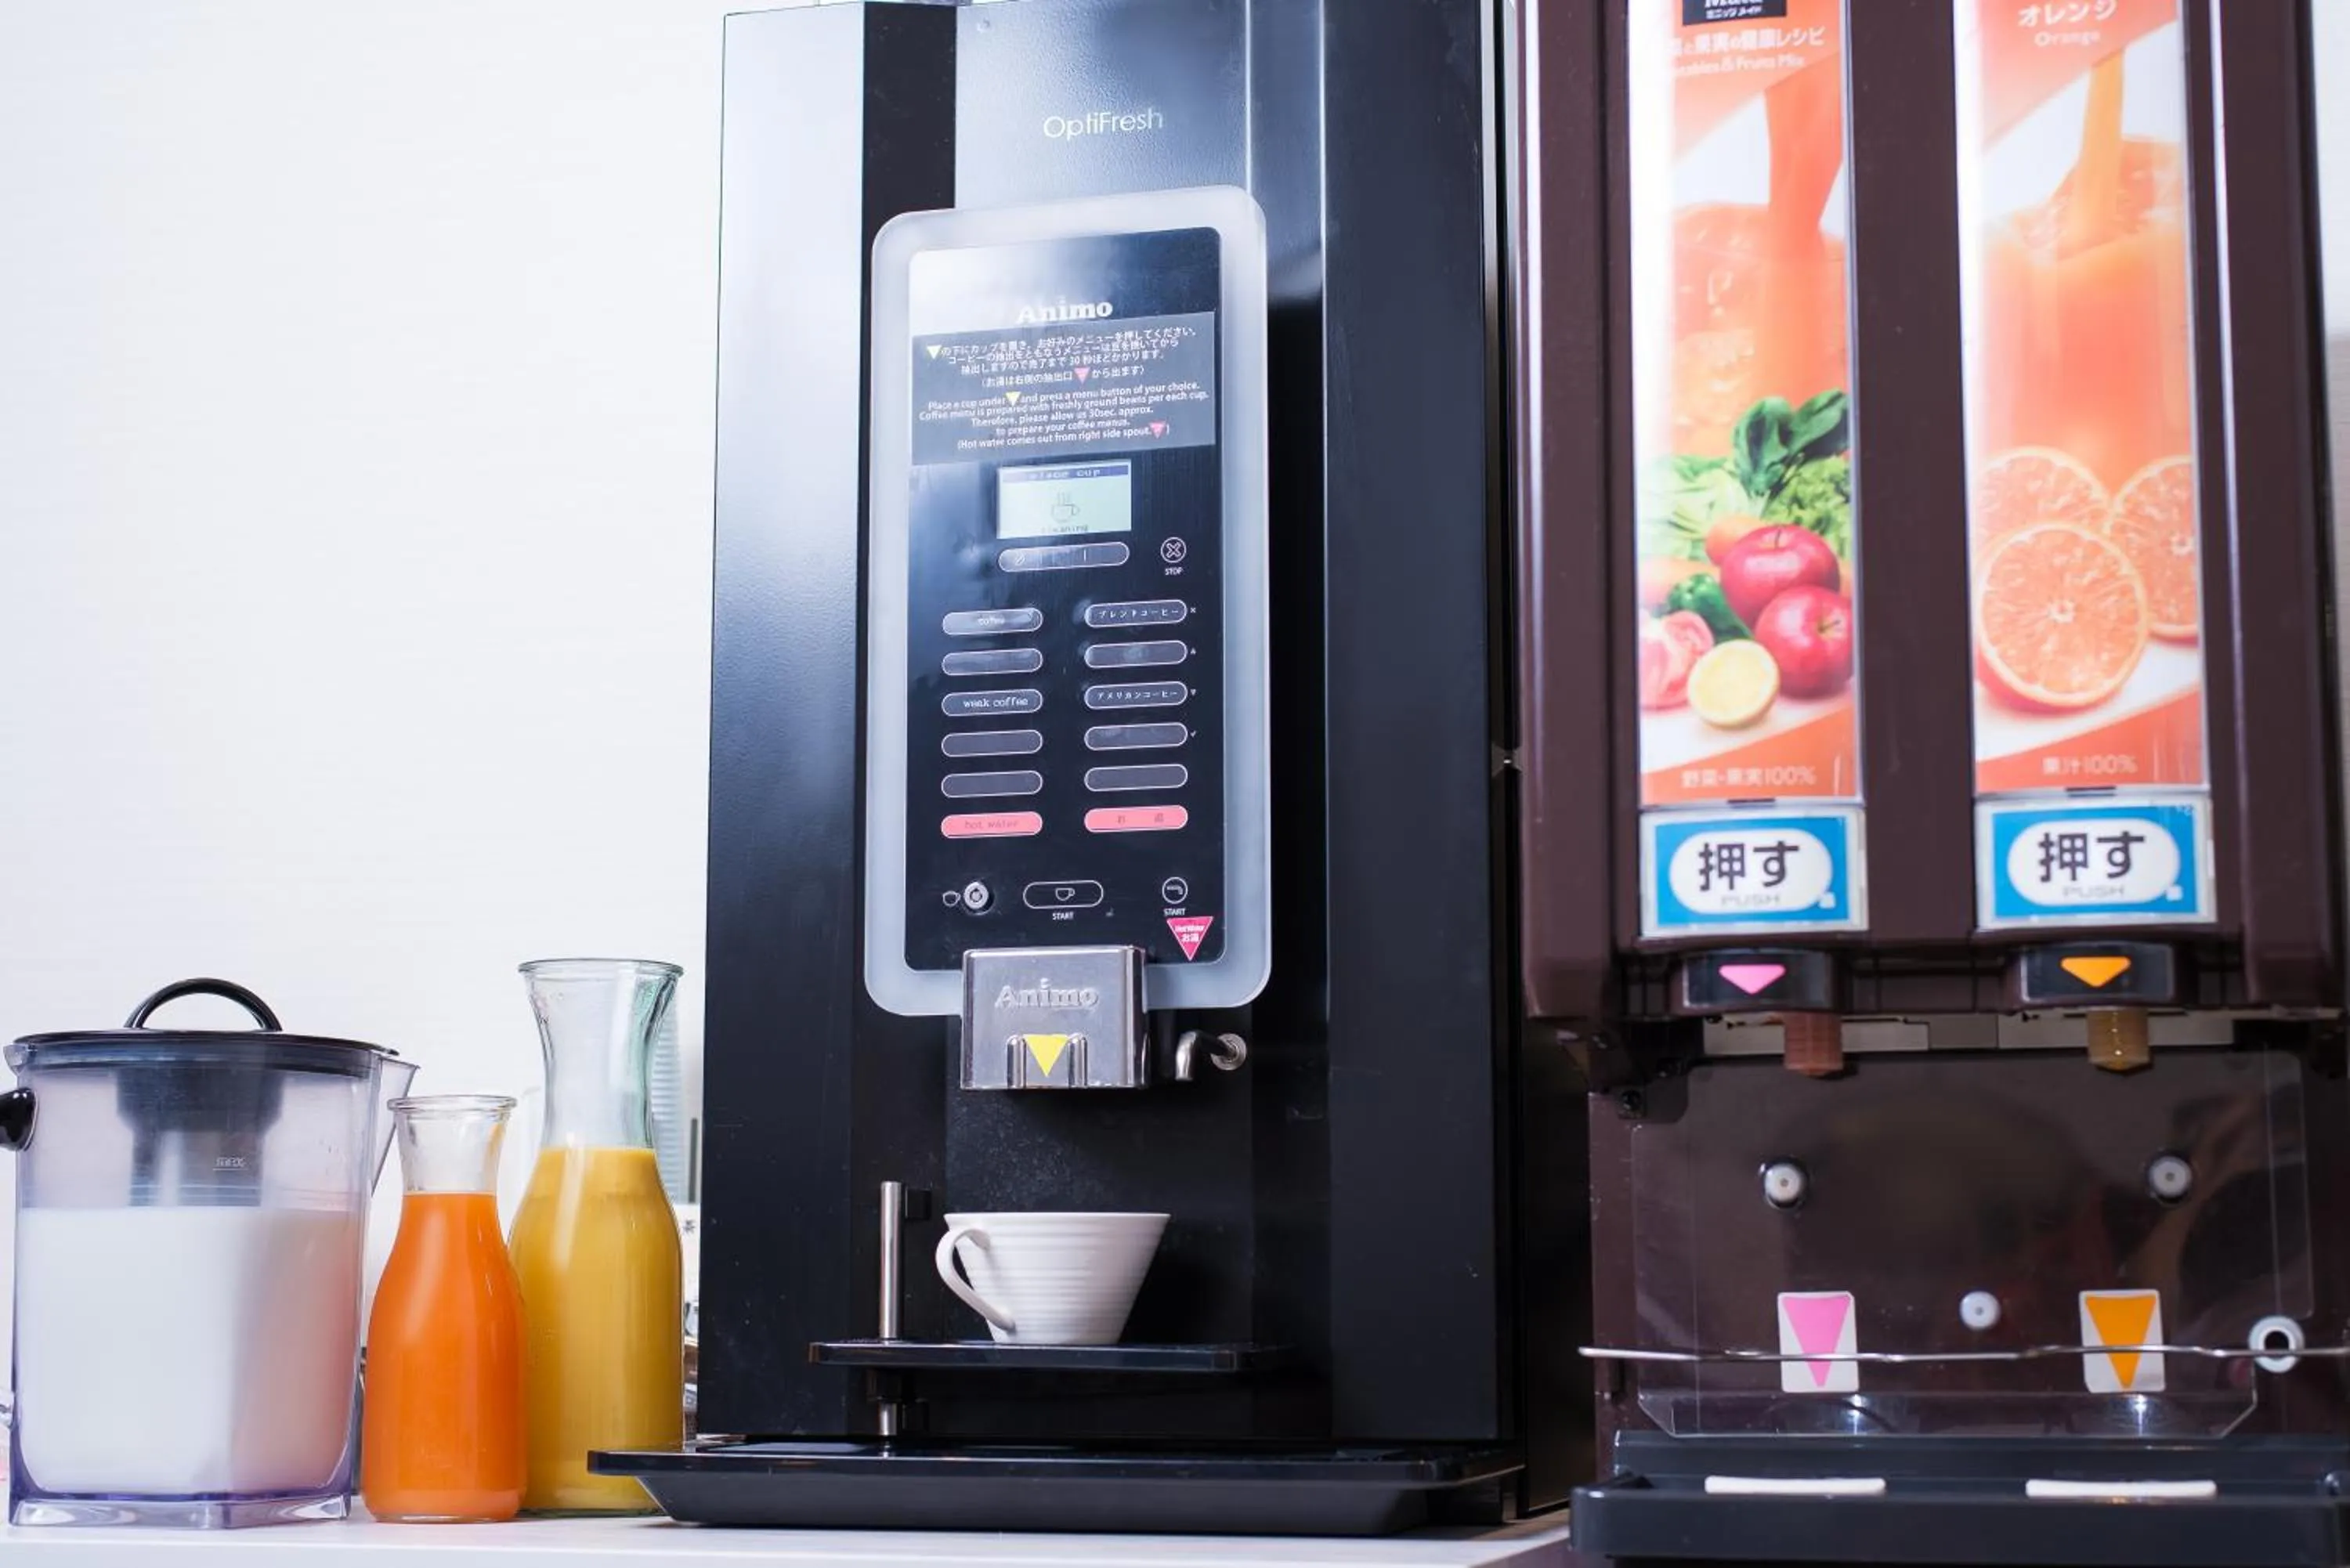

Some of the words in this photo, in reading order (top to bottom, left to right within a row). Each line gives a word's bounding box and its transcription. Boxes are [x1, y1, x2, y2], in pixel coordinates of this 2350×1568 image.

[2016, 0, 2118, 27] オレンジ
[1043, 107, 1163, 140] OptiFresh
[1016, 295, 1113, 324] Animo
[919, 410, 948, 421] Coffee
[949, 410, 975, 418] menu
[986, 404, 1028, 417] prepared
[1030, 403, 1050, 411] with
[1052, 399, 1083, 411] freshly
[1084, 397, 1117, 409] ground
[1119, 395, 1146, 405] beans
[1148, 395, 1164, 404] per
[1166, 392, 1187, 401] each
[1189, 392, 1209, 402] cup.
[929, 400, 952, 410] Place
[961, 400, 977, 409] cup
[978, 396, 1006, 406] under
[1021, 393, 1038, 403] and
[1040, 392, 1062, 403] press
[1072, 390, 1099, 399] menu
[1101, 386, 1131, 396] button
[1144, 385, 1166, 395] your
[1168, 381, 1200, 391] choice.
[971, 414, 1017, 428] Therefore,
[1019, 413, 1048, 425] please
[1050, 411, 1074, 421] allow
[1089, 407, 1117, 417] 30sec.
[1119, 406, 1153, 417] approx.
[957, 439, 977, 450] (Hot
[978, 439, 1005, 448] water
[1007, 437, 1036, 446] comes
[1037, 435, 1054, 443] out
[1055, 432, 1077, 442] from
[1079, 430, 1100, 443] right
[1102, 428, 1121, 439] side
[1123, 428, 1152, 439] spout.
[1007, 426, 1043, 437] prepare
[1046, 424, 1065, 433] your
[1067, 420, 1095, 430] coffee
[1165, 566, 1184, 576] STOP
[964, 698, 989, 708] weak
[992, 696, 1029, 707] coffee
[1097, 690, 1177, 700] アメリカンコーヒー
[964, 820, 984, 829] hot
[987, 818, 1019, 829] water
[1698, 841, 1799, 891] 押す
[2037, 830, 2146, 883] 押す
[1722, 894, 1781, 906] PUSH
[2063, 884, 2126, 898] PUSH
[1052, 912, 1073, 920] START
[1164, 908, 1186, 916] START
[994, 977, 1099, 1009] Animo
